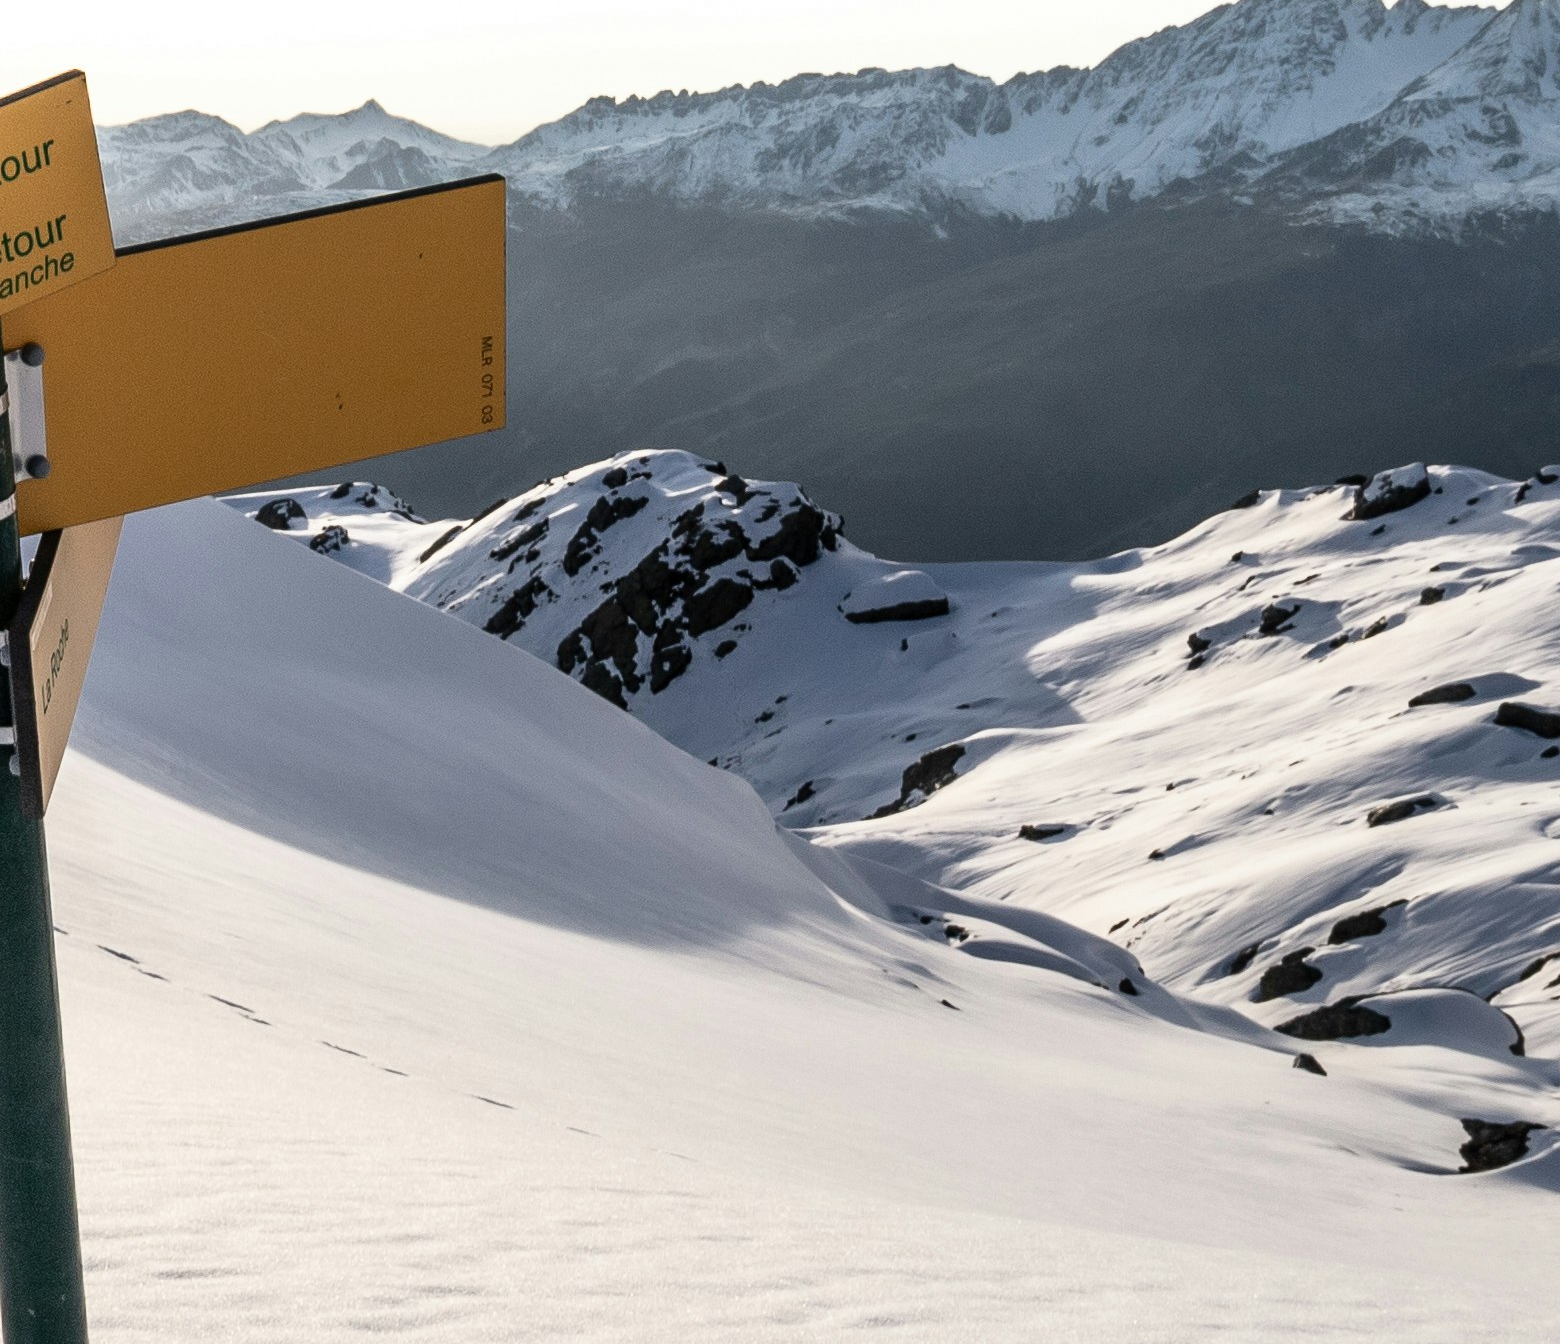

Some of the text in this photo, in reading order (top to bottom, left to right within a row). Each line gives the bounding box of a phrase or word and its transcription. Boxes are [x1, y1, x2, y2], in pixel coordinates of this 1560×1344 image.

[481, 335, 494, 425] MLR 071 03
[41, 618, 70, 715] La Roche
